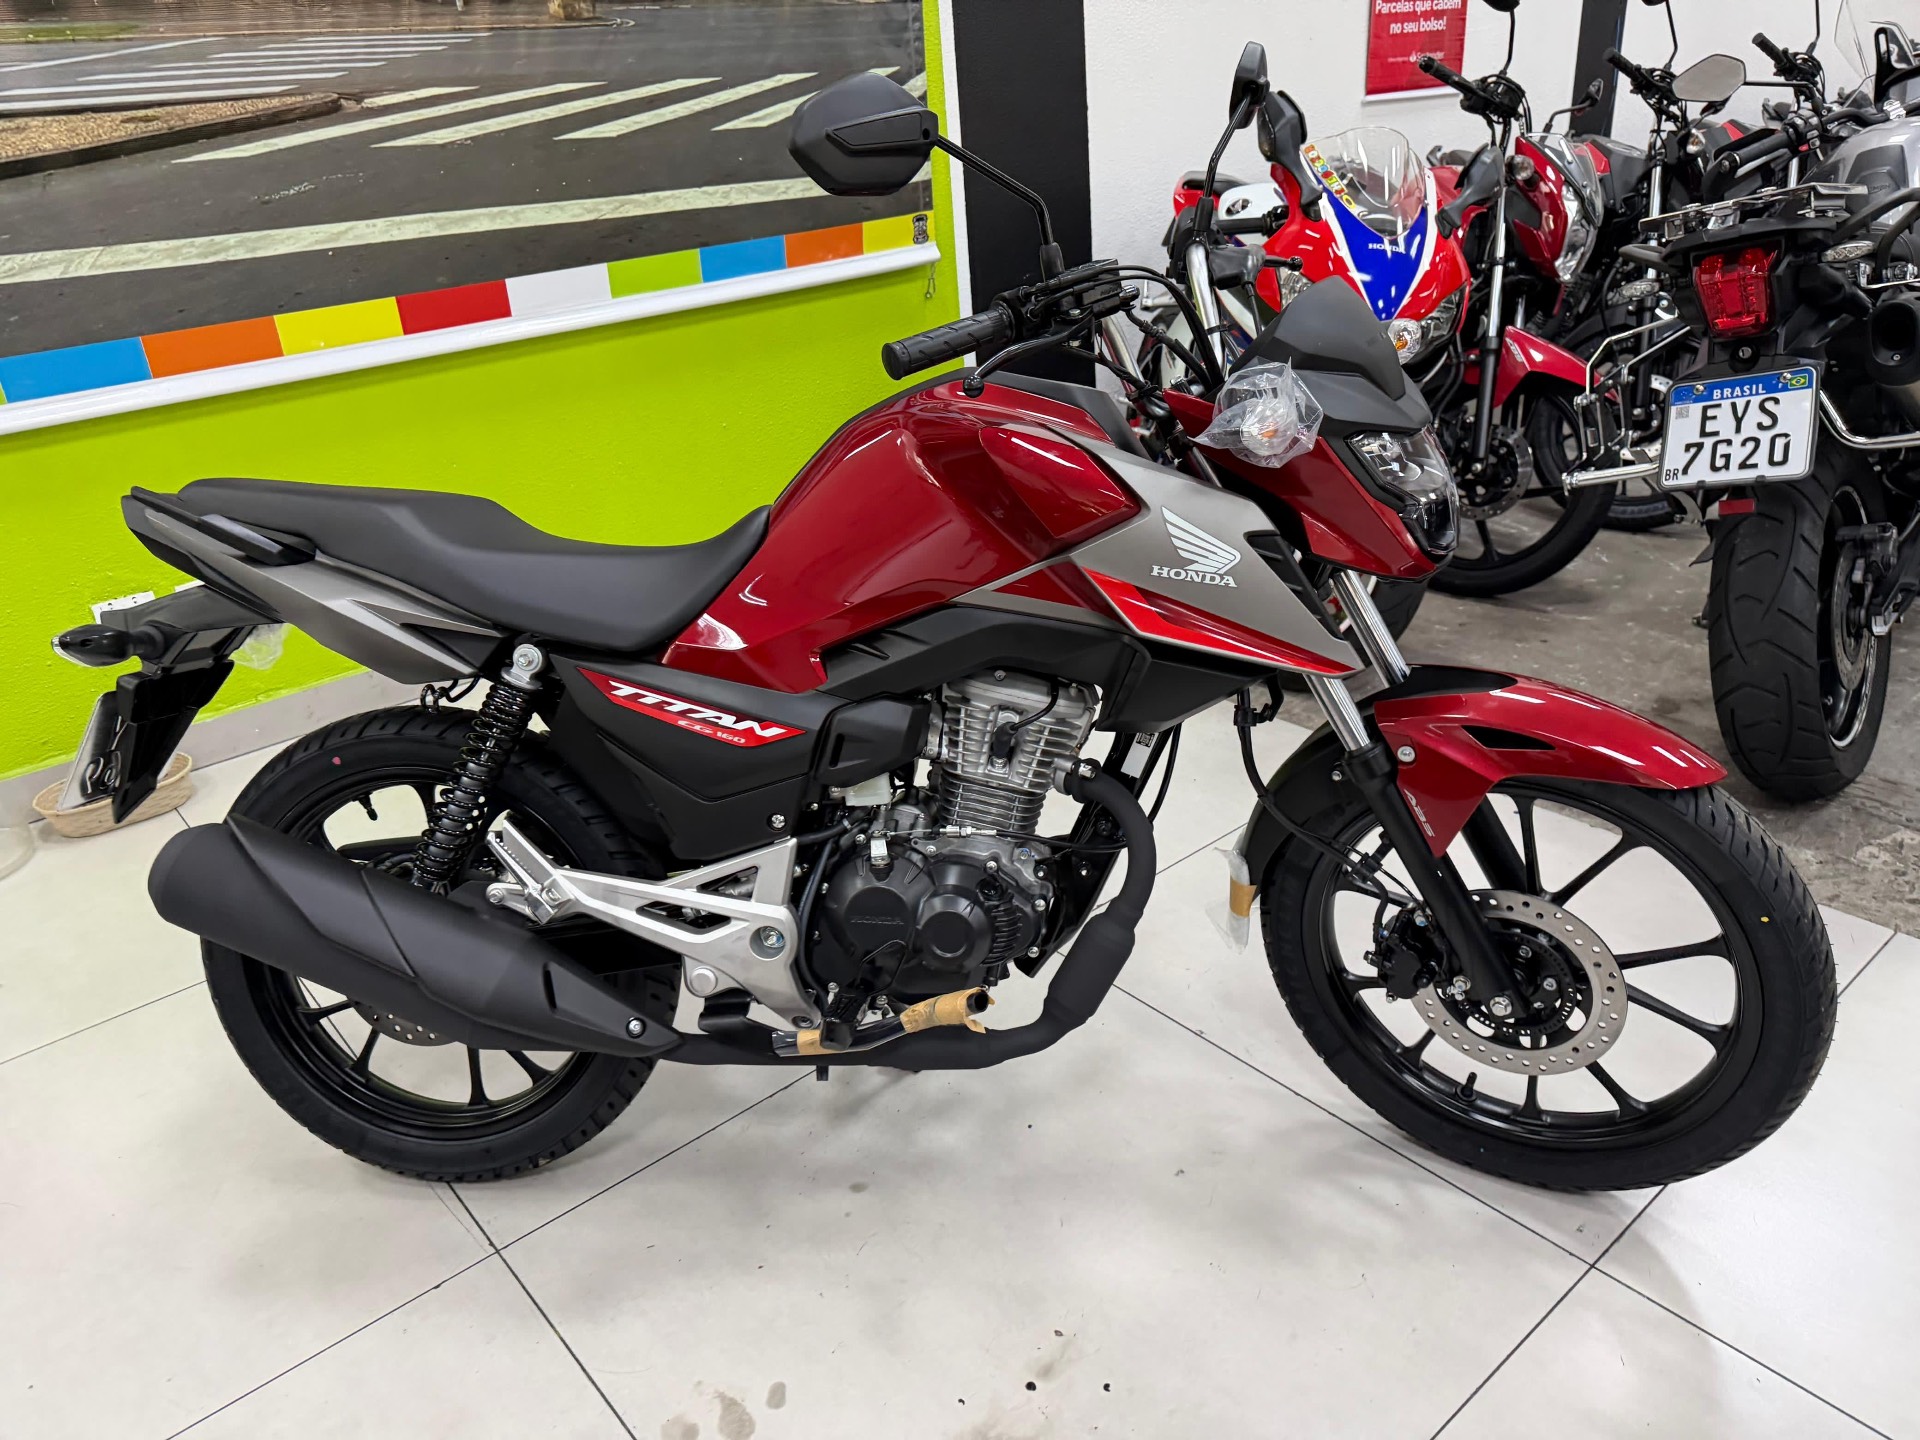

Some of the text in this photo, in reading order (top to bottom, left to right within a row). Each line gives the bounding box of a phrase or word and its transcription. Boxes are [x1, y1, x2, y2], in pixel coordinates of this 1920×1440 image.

[1375, 0, 1414, 14] Parcelas
[1415, 1, 1432, 15] que
[1389, 16, 1447, 35] no seu bolso!
[1713, 383, 1767, 400] BRASIL
[1700, 396, 1781, 438] EYS
[1681, 432, 1792, 476] 7G20
[1664, 468, 1680, 482] BR
[1150, 565, 1238, 588] HONDA
[608, 680, 788, 738] TITAN
[716, 731, 746, 744] 160
[1403, 788, 1436, 837] ABS
